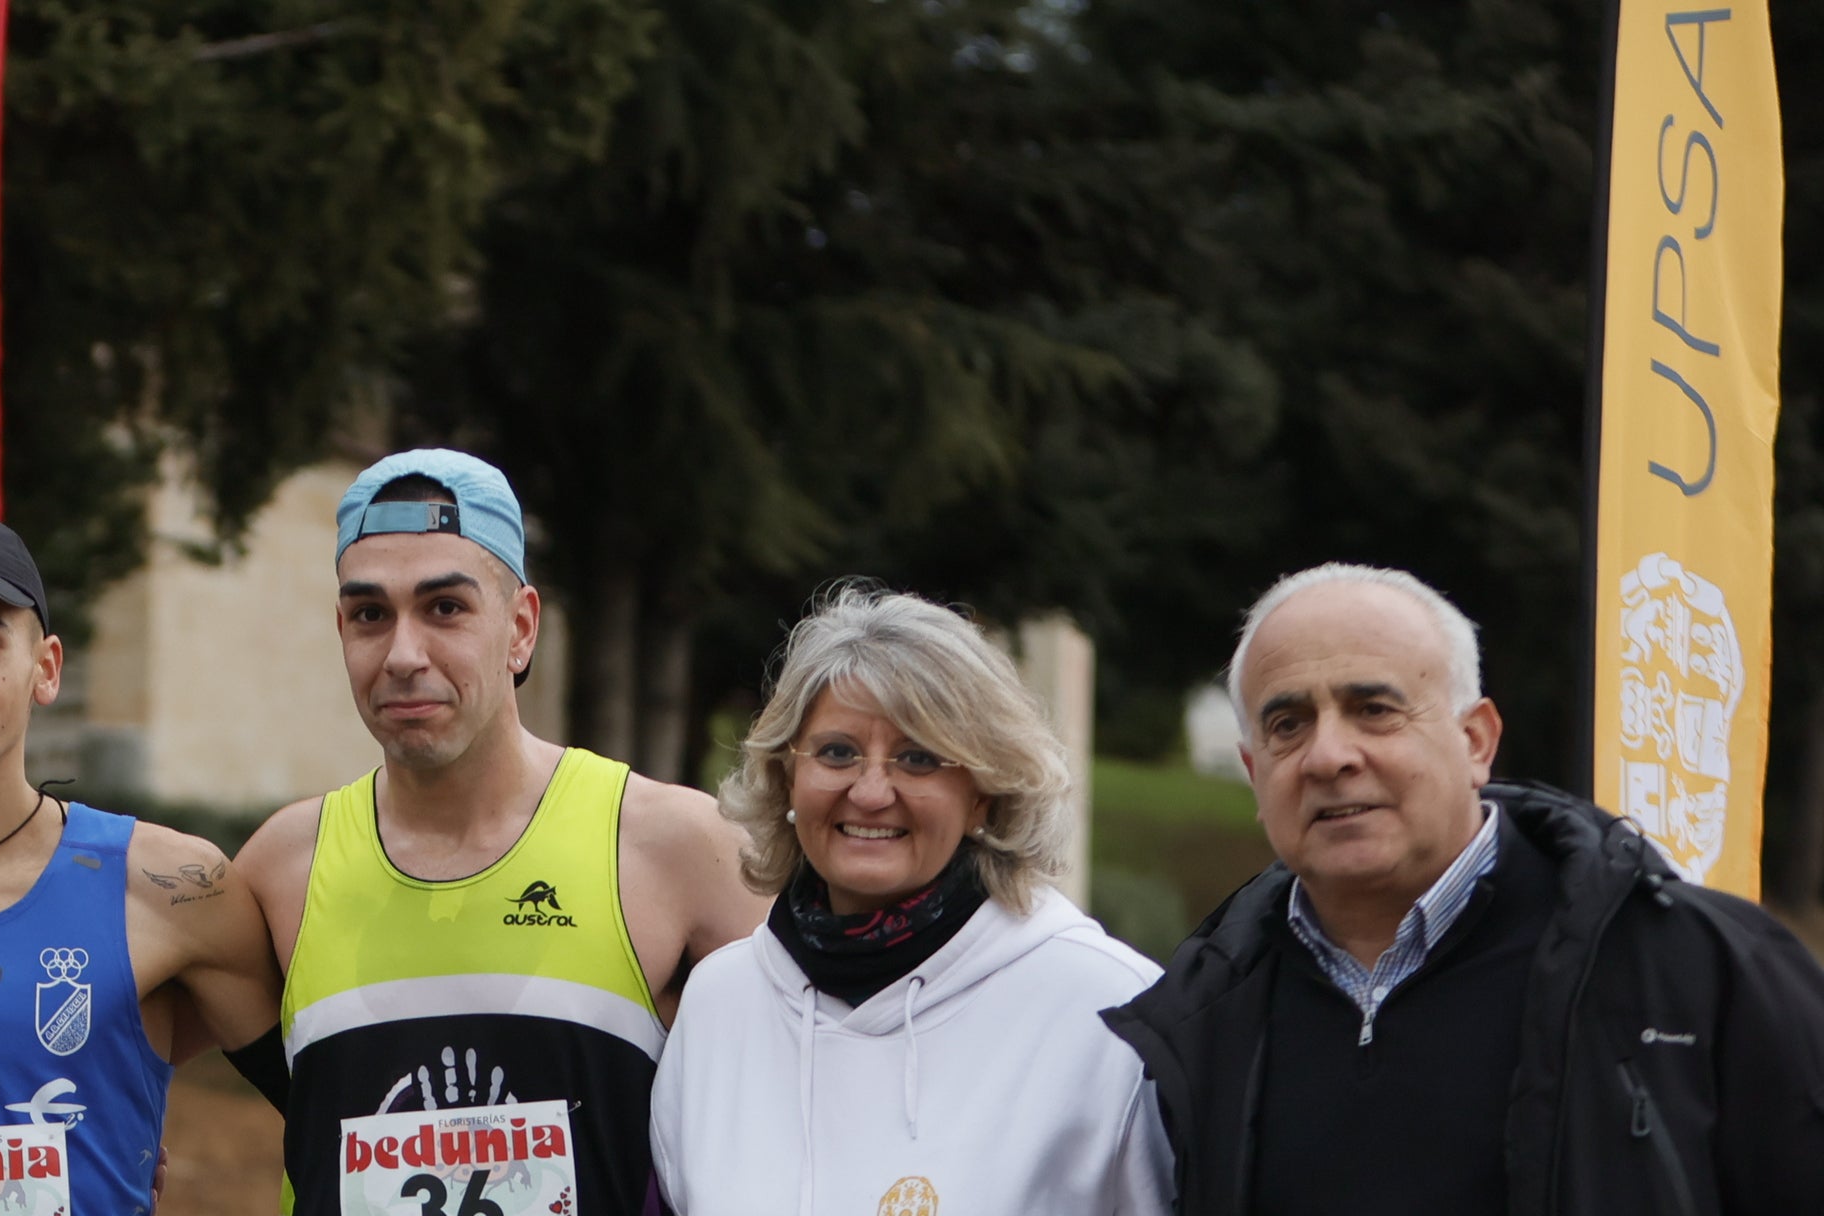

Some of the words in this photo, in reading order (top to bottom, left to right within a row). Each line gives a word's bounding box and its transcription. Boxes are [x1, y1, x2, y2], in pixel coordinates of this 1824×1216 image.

[1647, 8, 1732, 498] UPSA
[503, 911, 578, 928] austral
[438, 1114, 506, 1129] FLORISTERÍAS
[346, 1118, 566, 1174] bedunia
